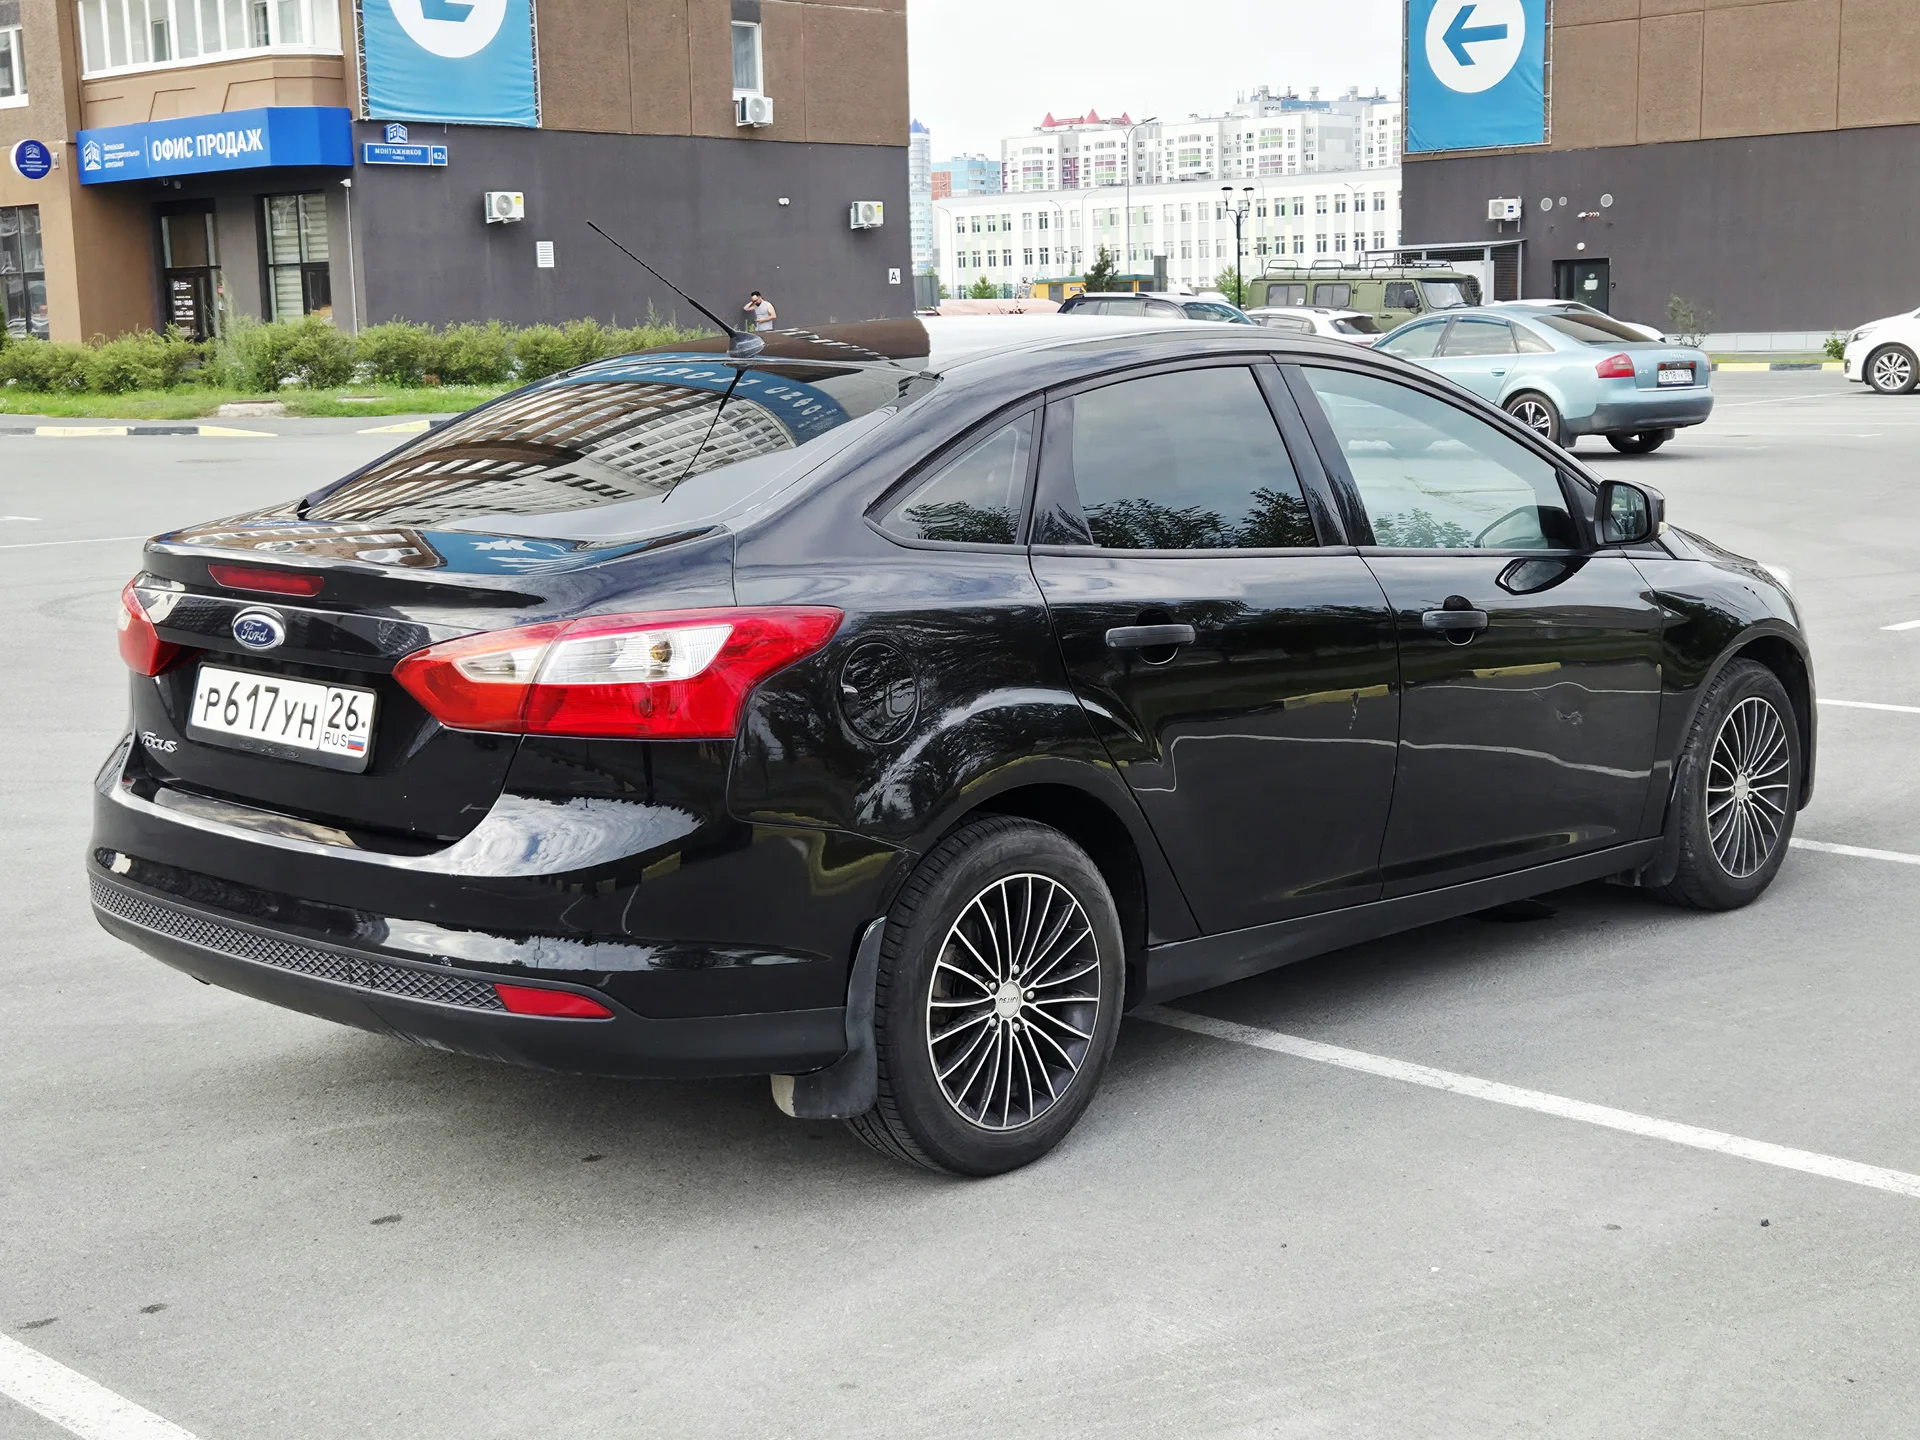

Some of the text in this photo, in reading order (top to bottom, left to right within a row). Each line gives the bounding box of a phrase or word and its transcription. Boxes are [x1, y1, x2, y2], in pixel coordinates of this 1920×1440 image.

[152, 128, 263, 162] ОФИС ПРОДАЖ
[240, 620, 267, 643] Ford
[203, 681, 359, 741] Р617УН 26
[323, 731, 347, 748] RUS
